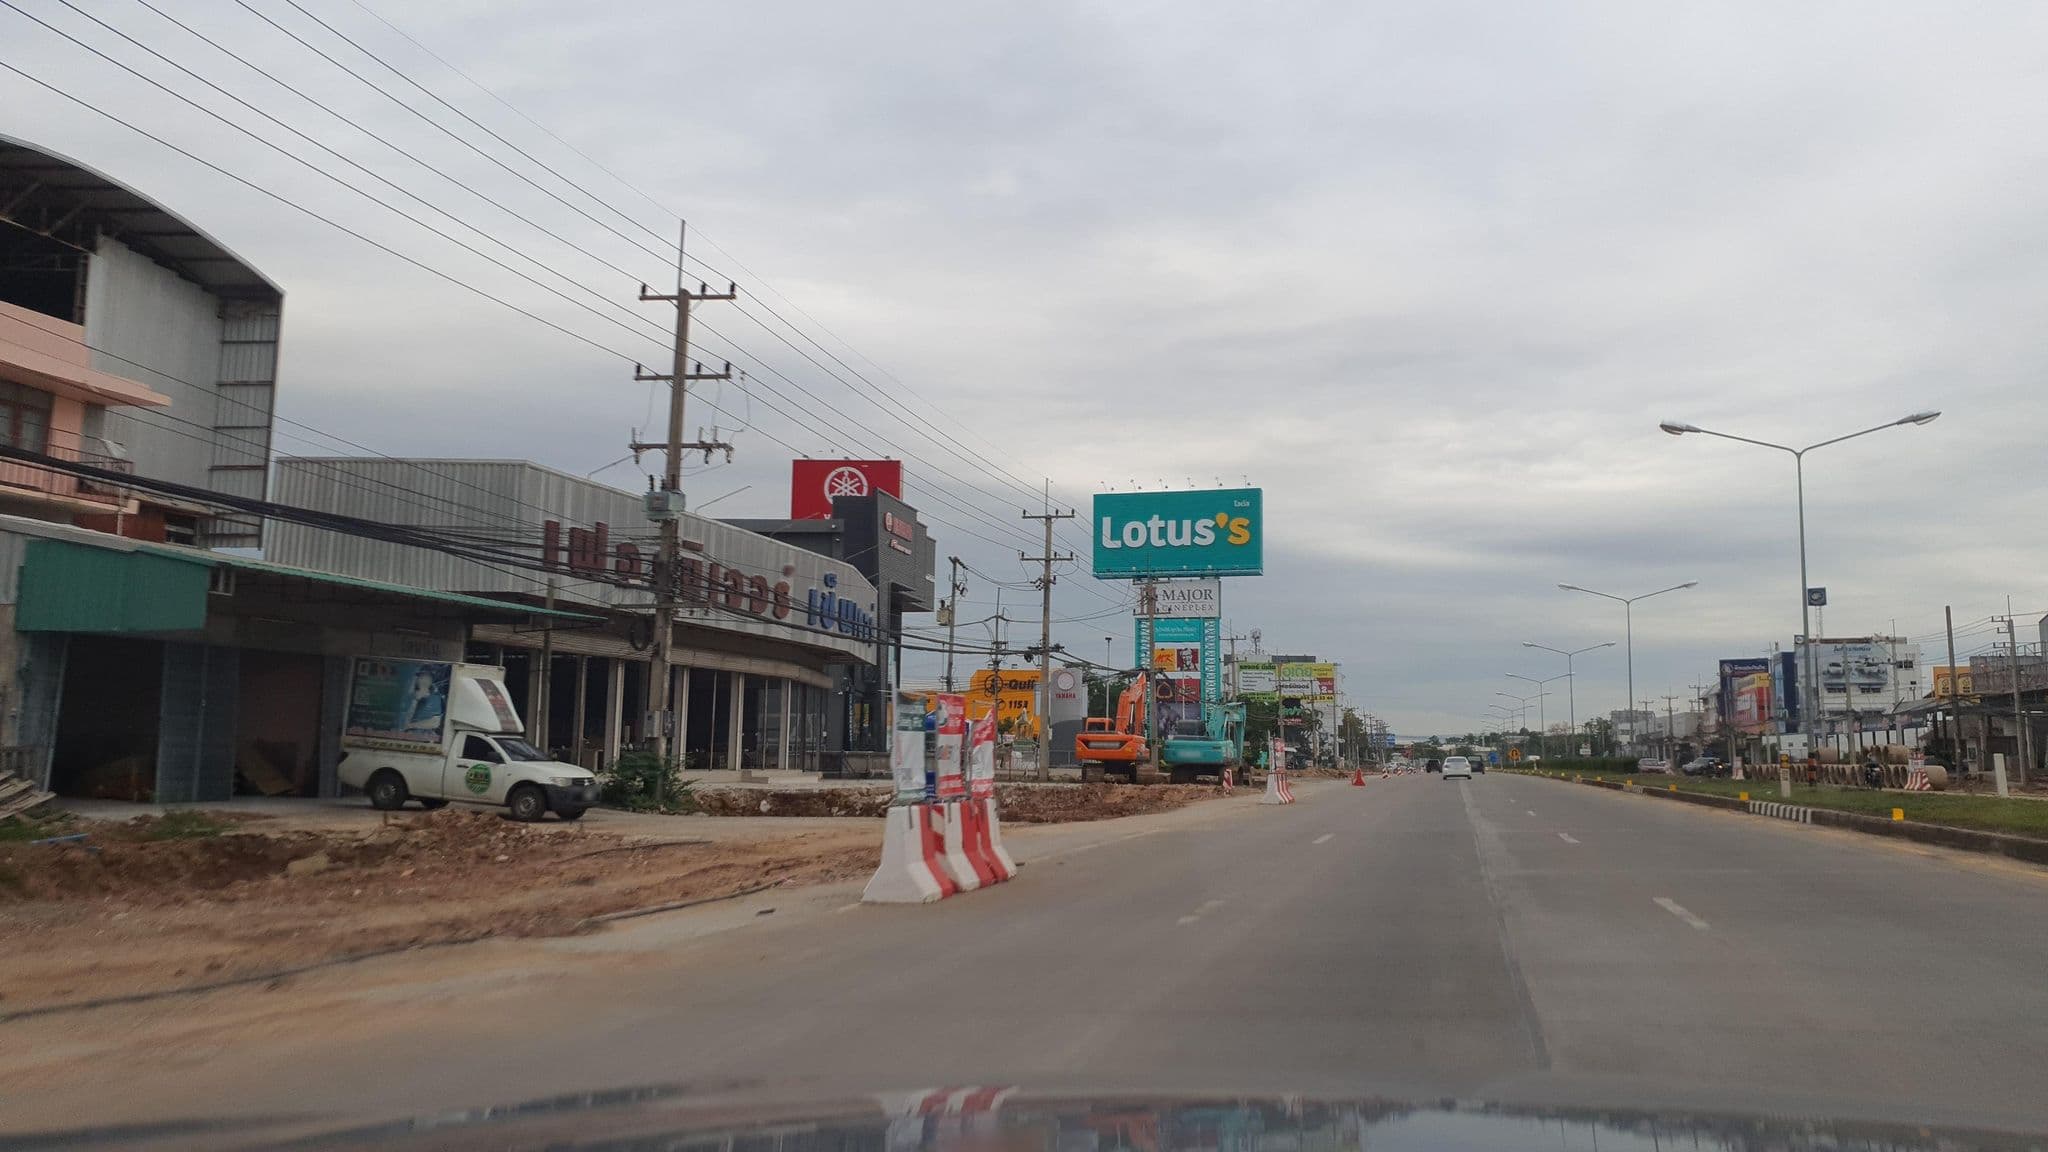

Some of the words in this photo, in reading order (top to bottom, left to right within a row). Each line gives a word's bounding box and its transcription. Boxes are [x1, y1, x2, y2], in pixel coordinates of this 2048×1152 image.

[1102, 511, 1251, 549] Lotus's
[544, 519, 795, 620] เฟอนิเจอร์
[1162, 588, 1214, 602] MAJOR
